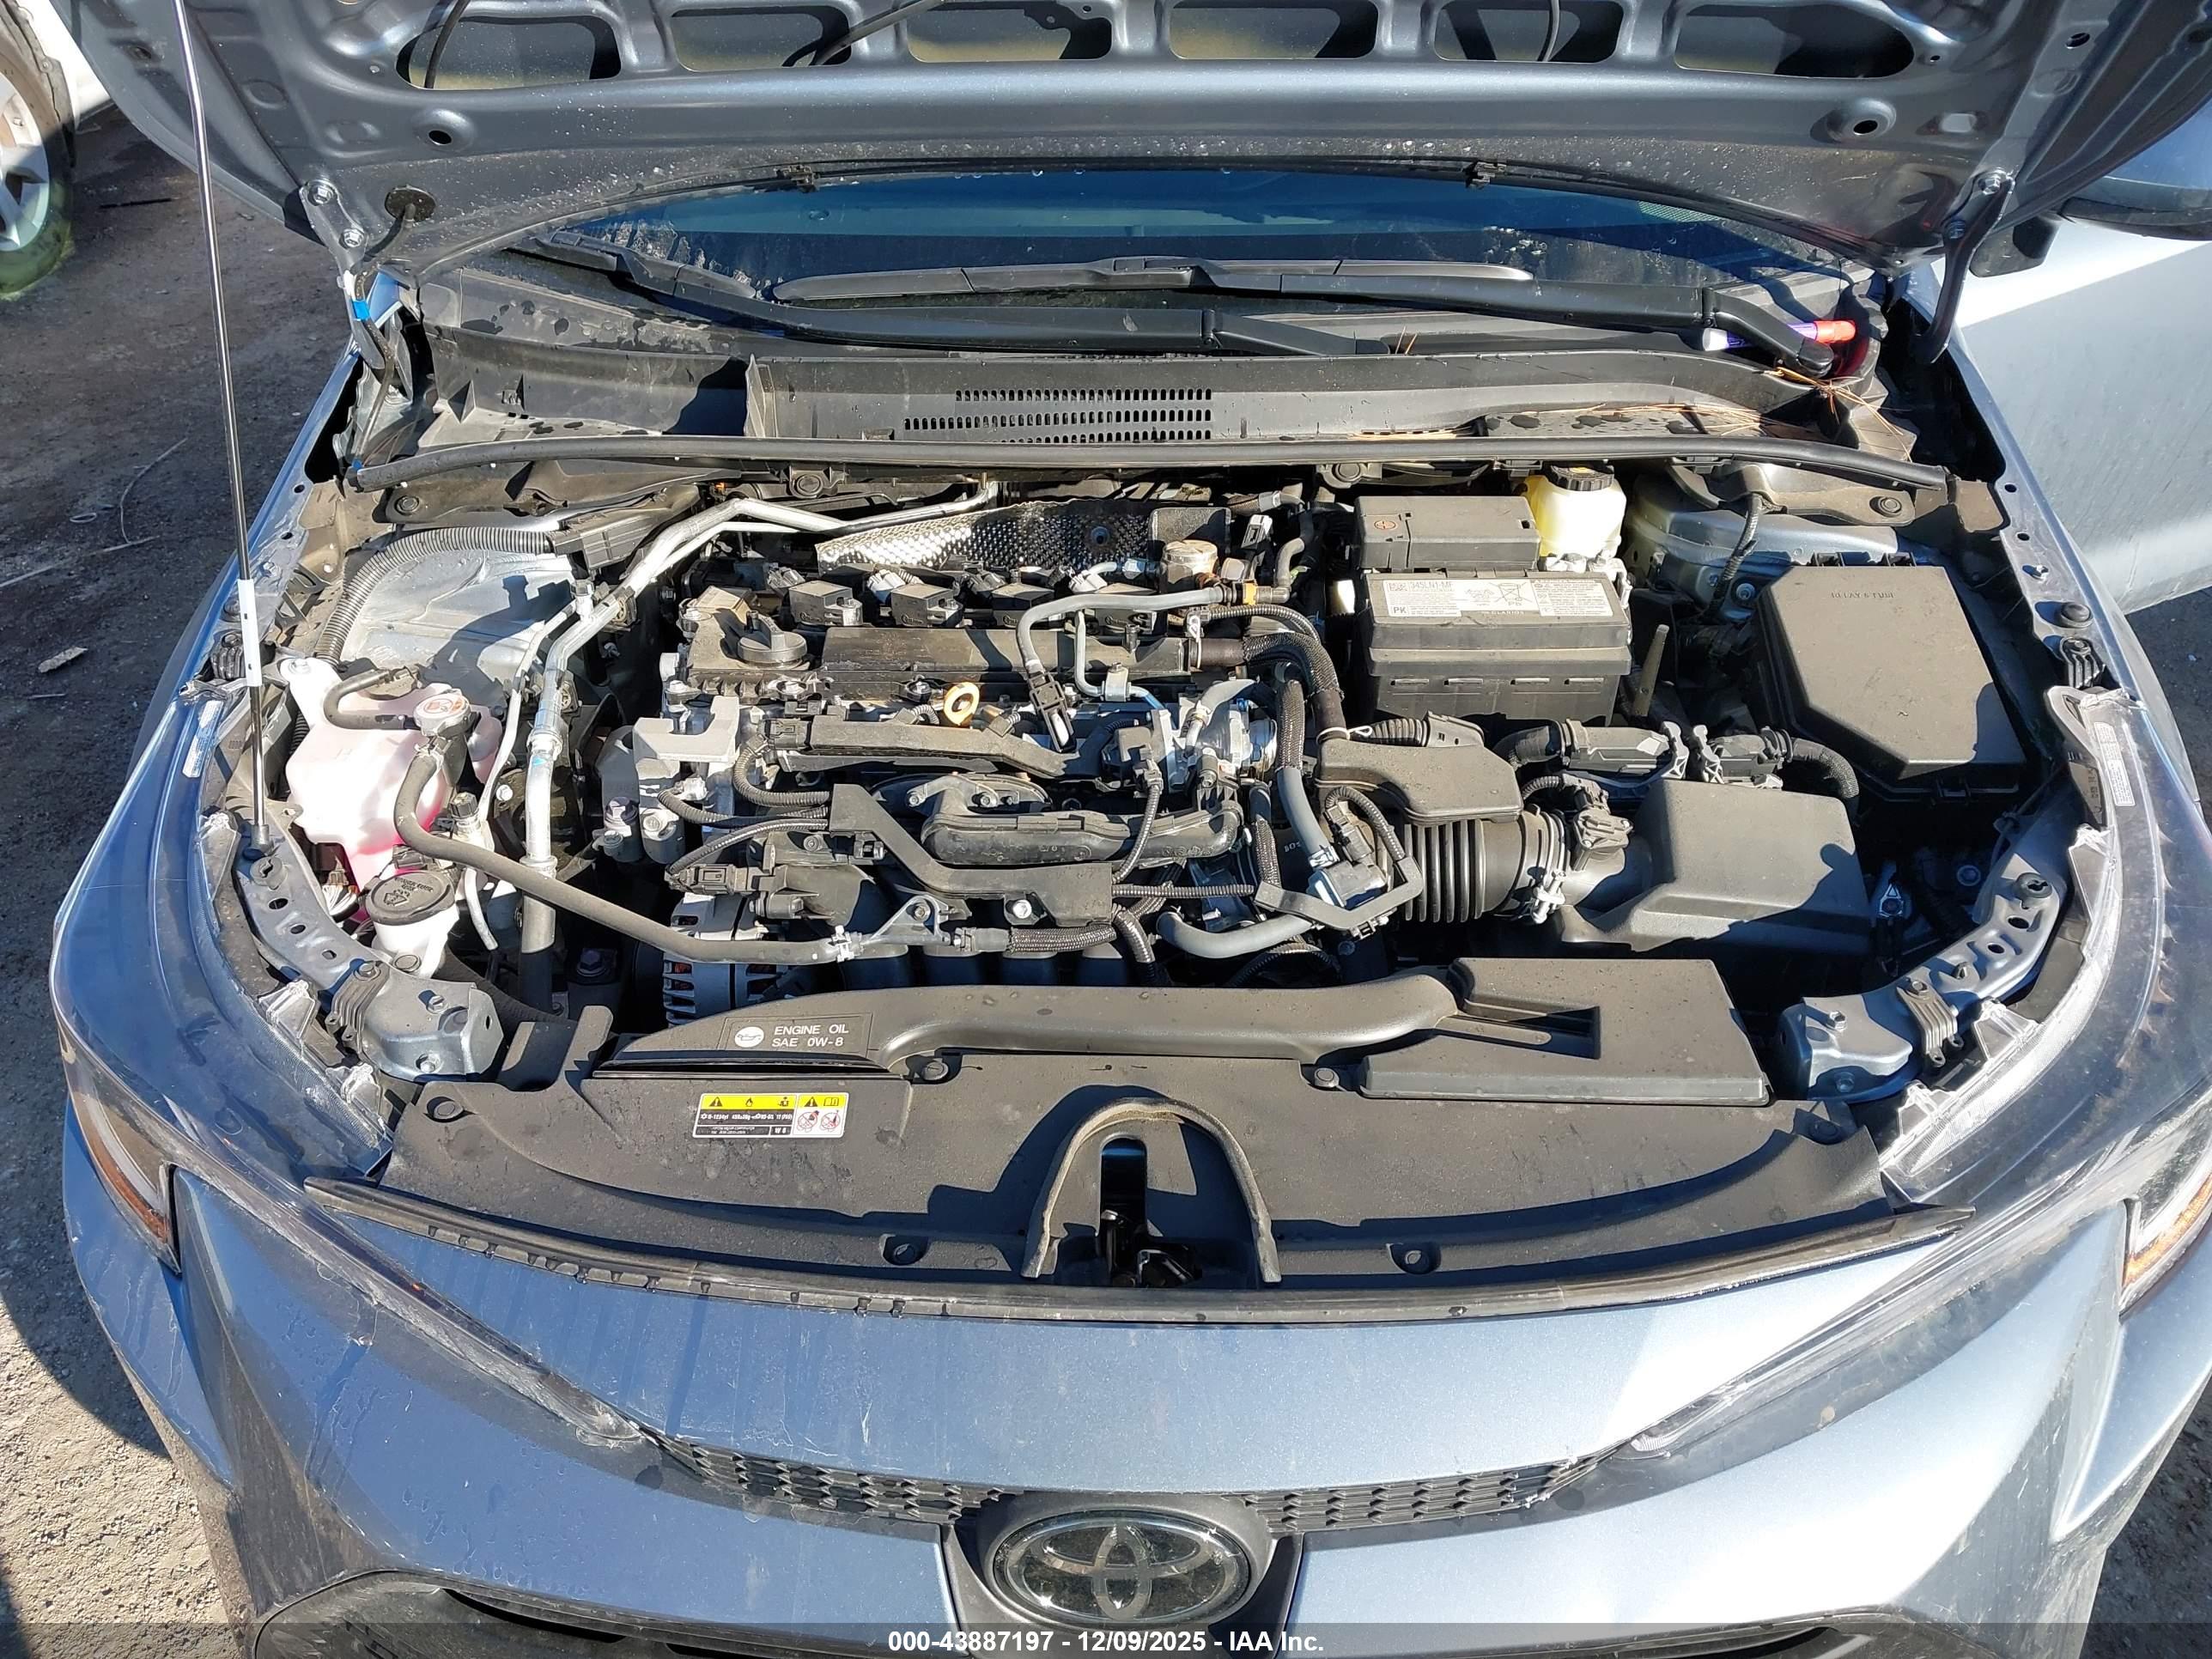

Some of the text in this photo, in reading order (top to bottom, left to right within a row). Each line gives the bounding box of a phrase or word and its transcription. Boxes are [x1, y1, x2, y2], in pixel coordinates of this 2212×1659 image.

[774, 1024, 849, 1036] ENGINE OIL
[772, 1036, 844, 1047] SAE 0W-8
